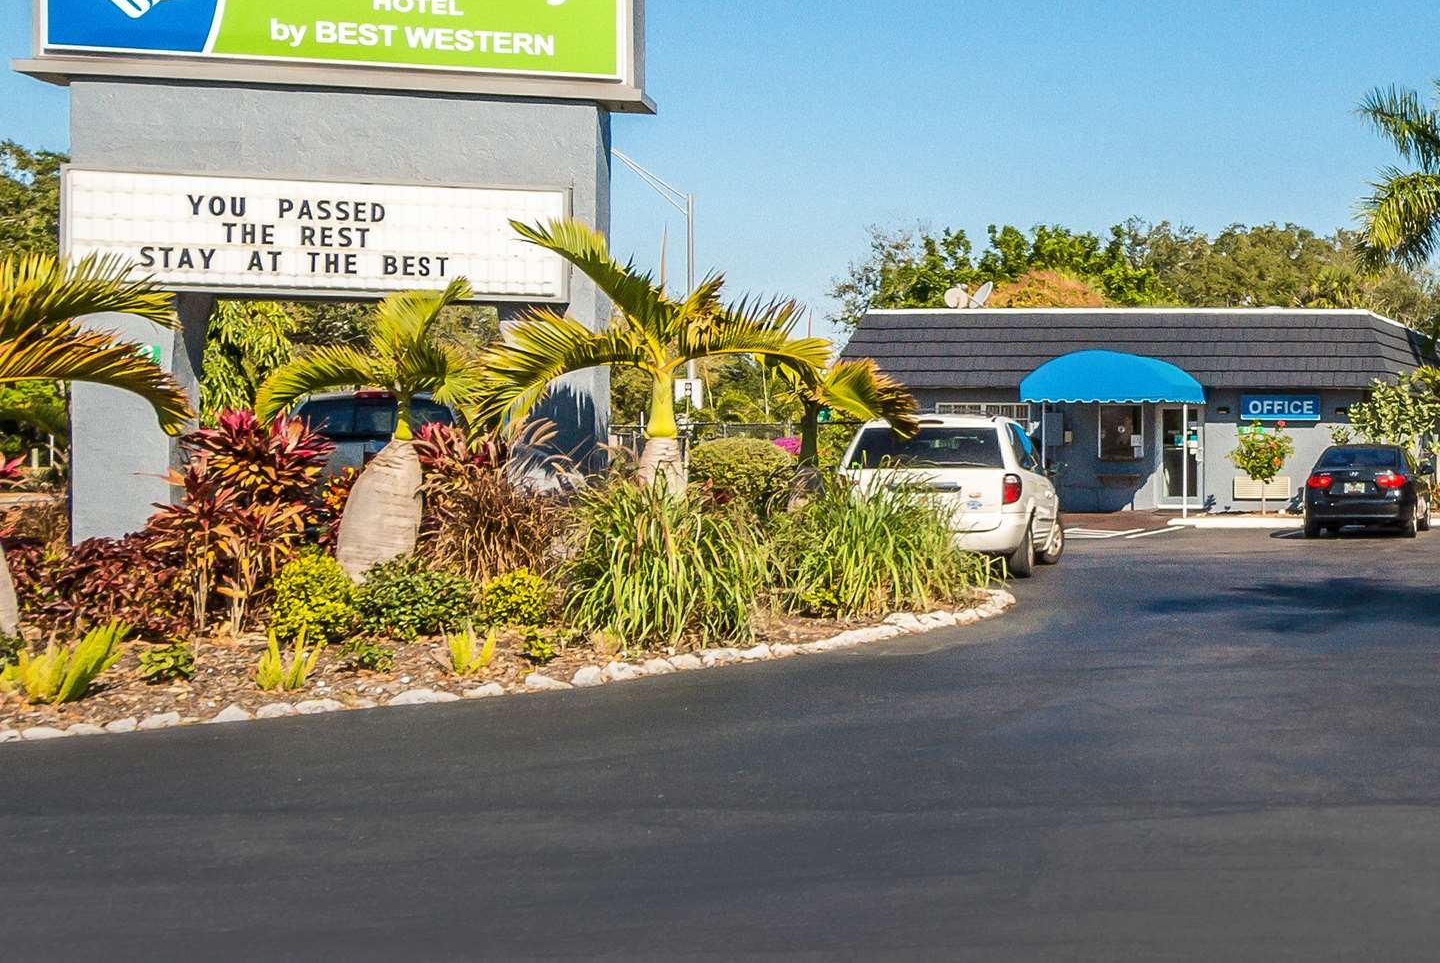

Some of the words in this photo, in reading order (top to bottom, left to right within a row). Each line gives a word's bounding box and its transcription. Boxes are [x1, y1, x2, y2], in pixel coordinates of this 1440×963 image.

[269, 17, 308, 48] by
[314, 20, 399, 47] BEST
[403, 25, 556, 57] WESTERN
[187, 194, 246, 217] YOU
[278, 198, 387, 223] PASSED
[222, 222, 275, 245] THE
[301, 225, 370, 248] REST
[139, 246, 217, 270] STAY
[247, 250, 282, 272] AT
[306, 252, 357, 275] THE
[383, 255, 450, 277] BEST
[1248, 400, 1314, 414] OFFICE
